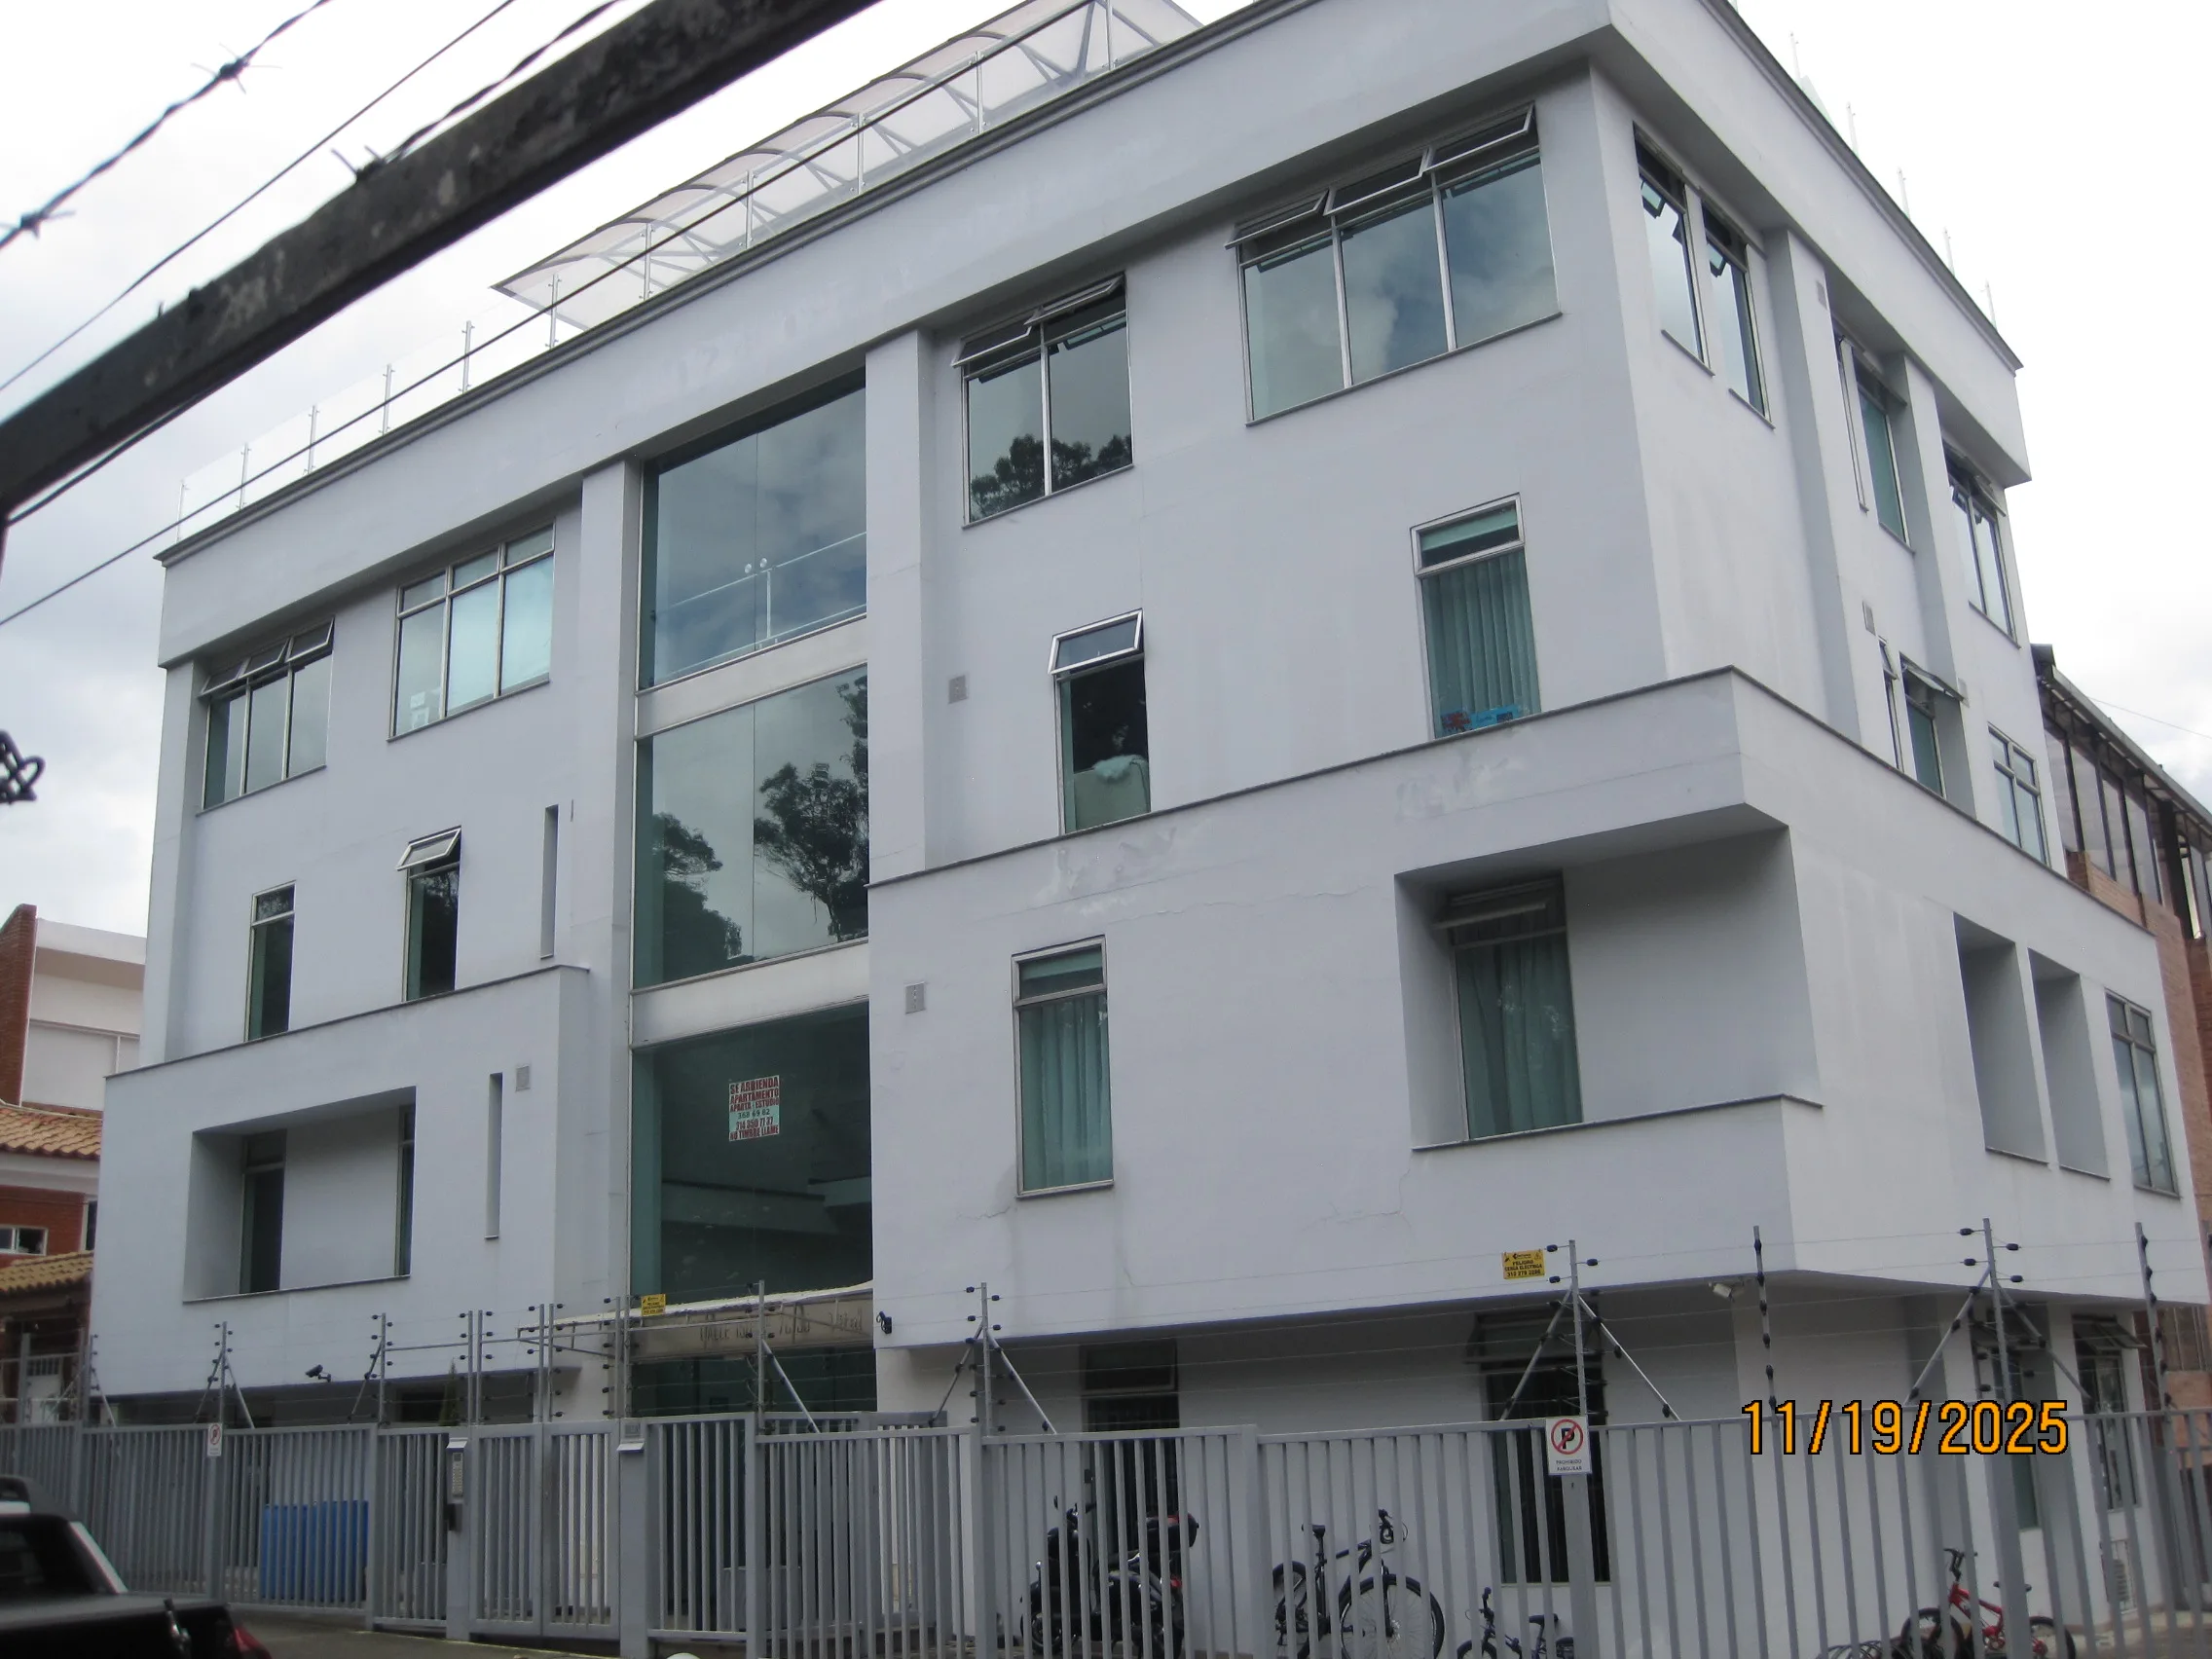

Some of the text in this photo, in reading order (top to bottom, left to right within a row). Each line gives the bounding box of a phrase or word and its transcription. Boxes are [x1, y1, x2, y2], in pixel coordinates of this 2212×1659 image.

[730, 1077, 779, 1094] SE ARRIENDA
[730, 1088, 779, 1104] APARTAMENTO
